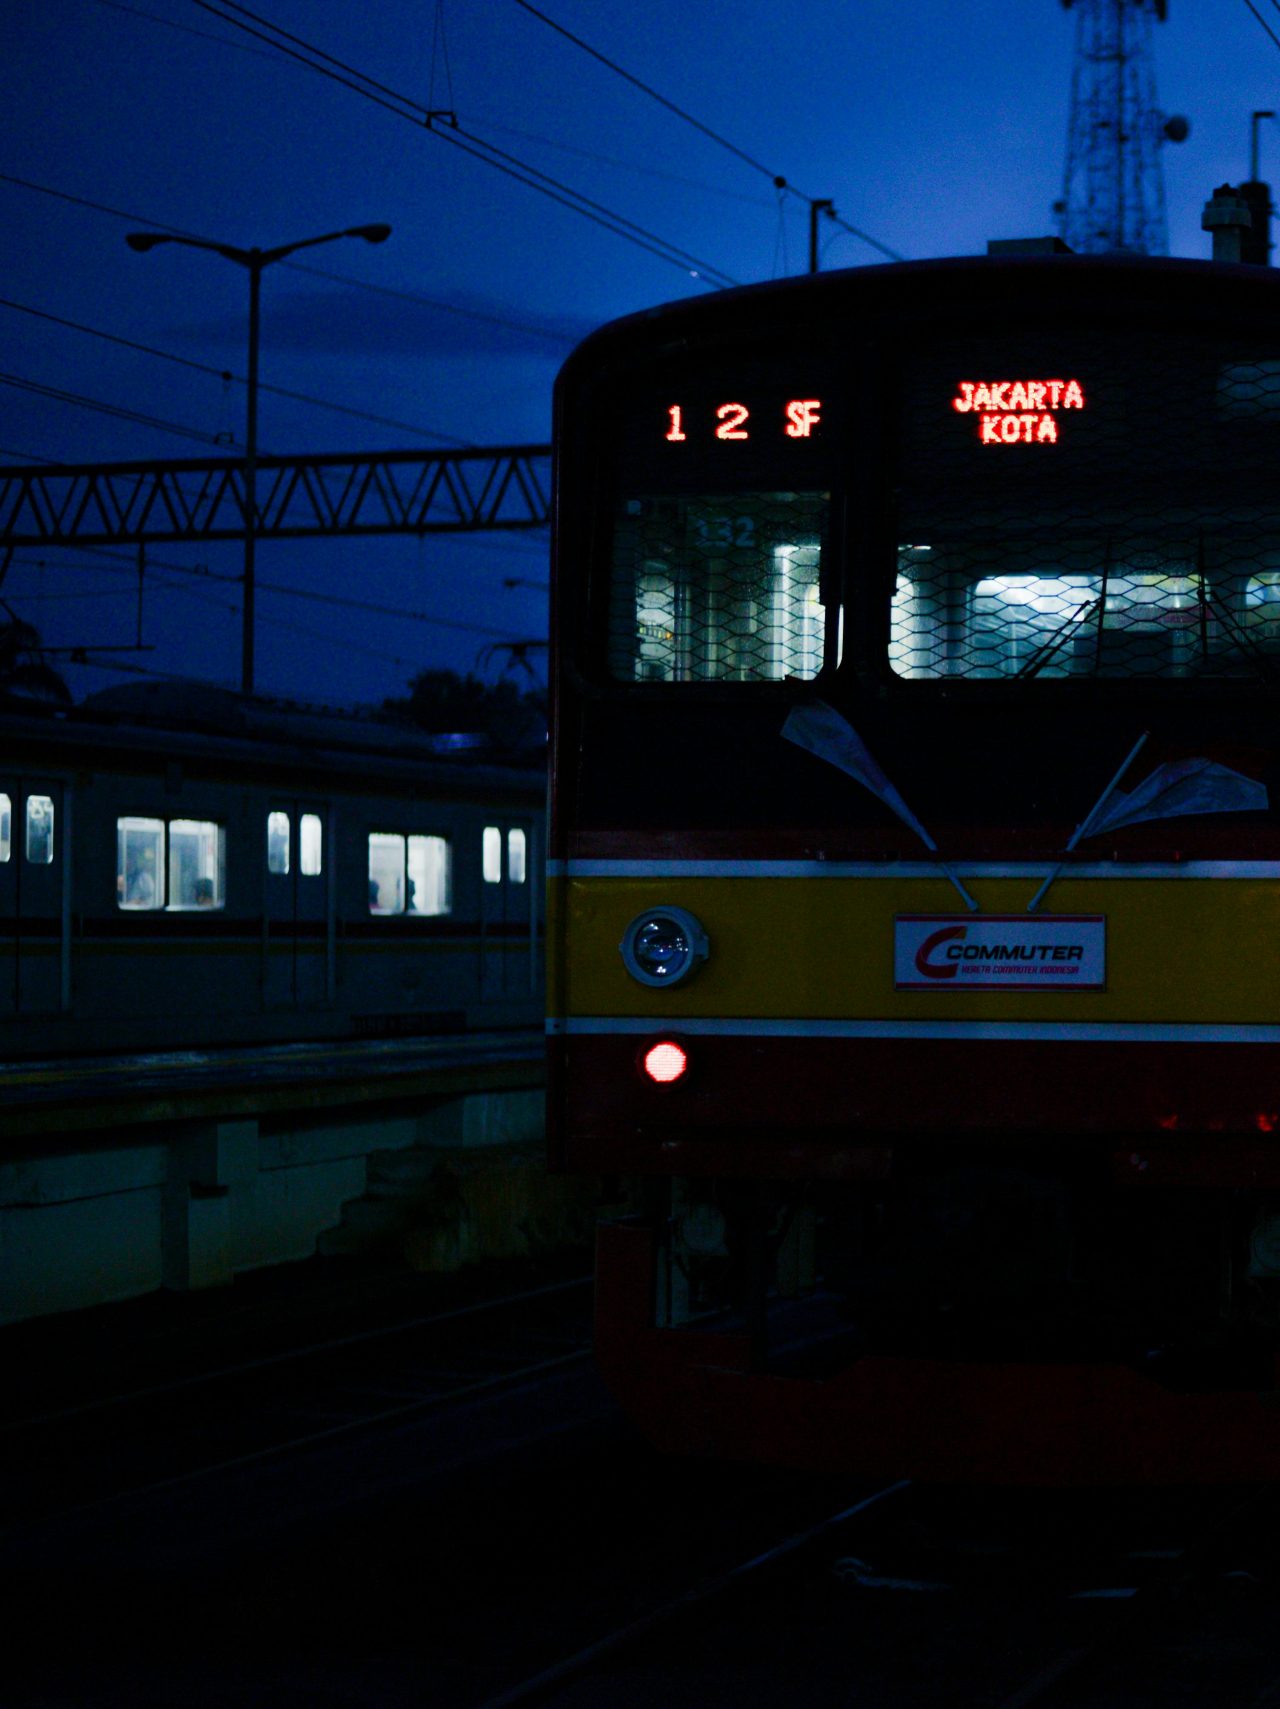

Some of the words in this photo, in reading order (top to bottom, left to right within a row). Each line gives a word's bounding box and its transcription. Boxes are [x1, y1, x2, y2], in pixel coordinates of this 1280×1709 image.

[952, 379, 1085, 412] JAKARTA
[785, 399, 821, 438] SF
[979, 413, 1058, 444] KOTA
[946, 945, 1085, 961] COMMUTER
